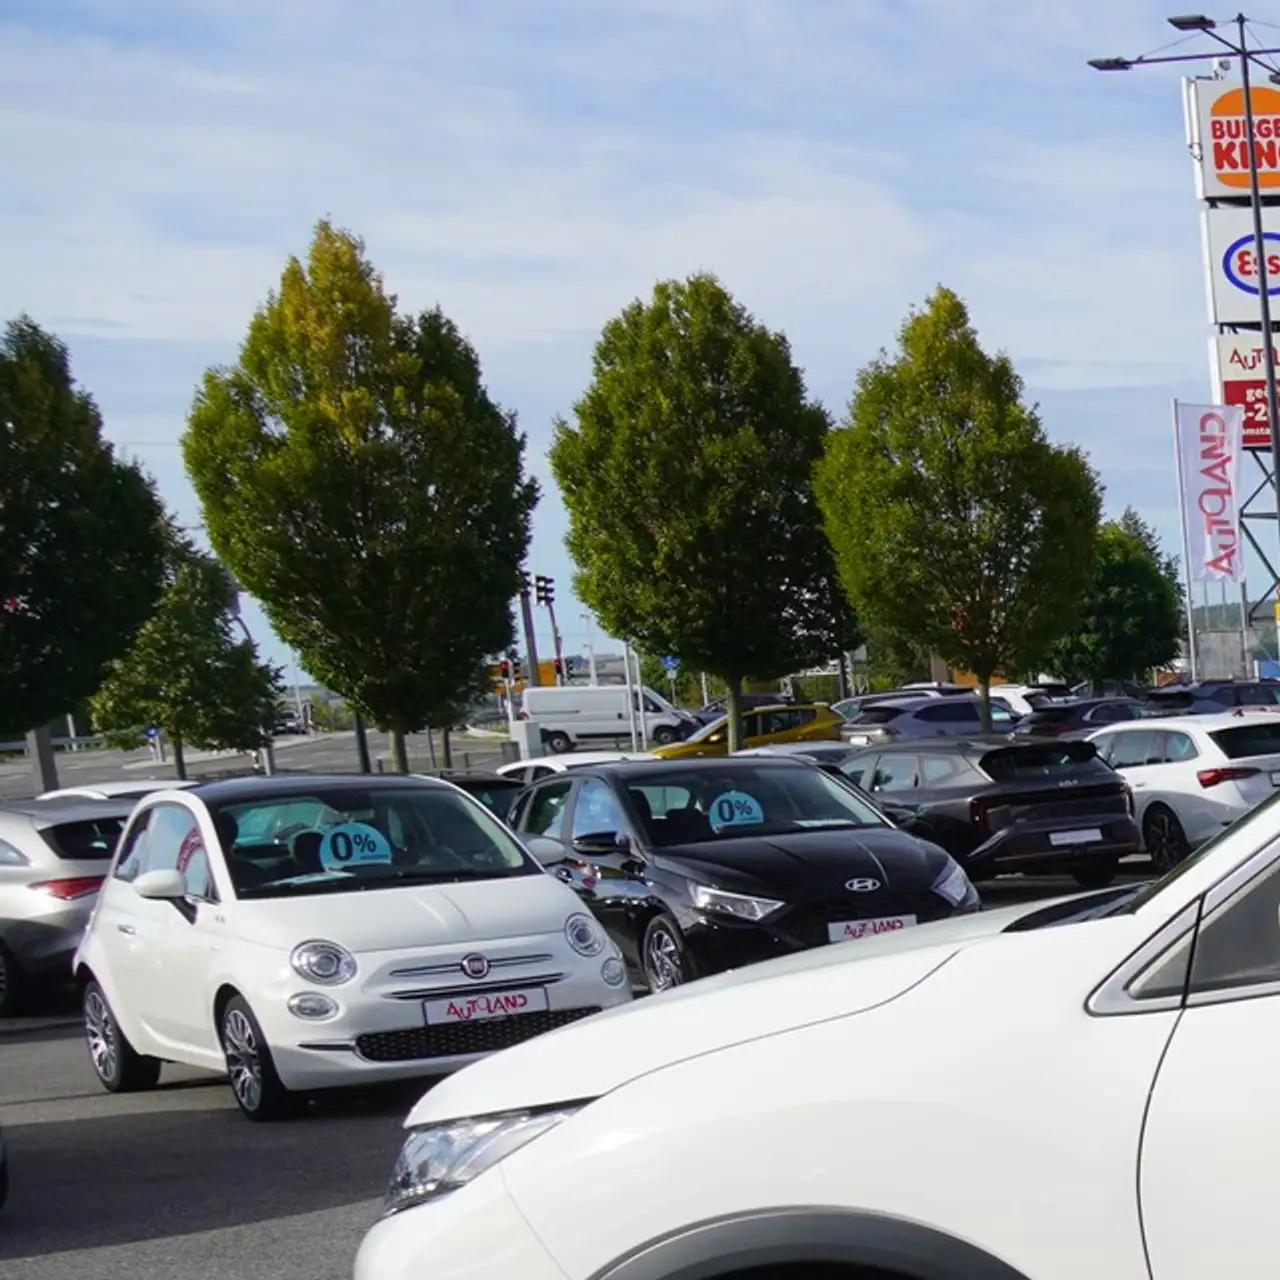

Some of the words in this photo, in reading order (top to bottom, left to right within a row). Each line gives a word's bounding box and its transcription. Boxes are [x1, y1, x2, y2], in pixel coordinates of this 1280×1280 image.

[1198, 412, 1237, 577] AUTOLAND
[717, 799, 753, 822] 0%
[330, 831, 378, 861] 0%
[446, 994, 528, 1020] AUTOLAND
